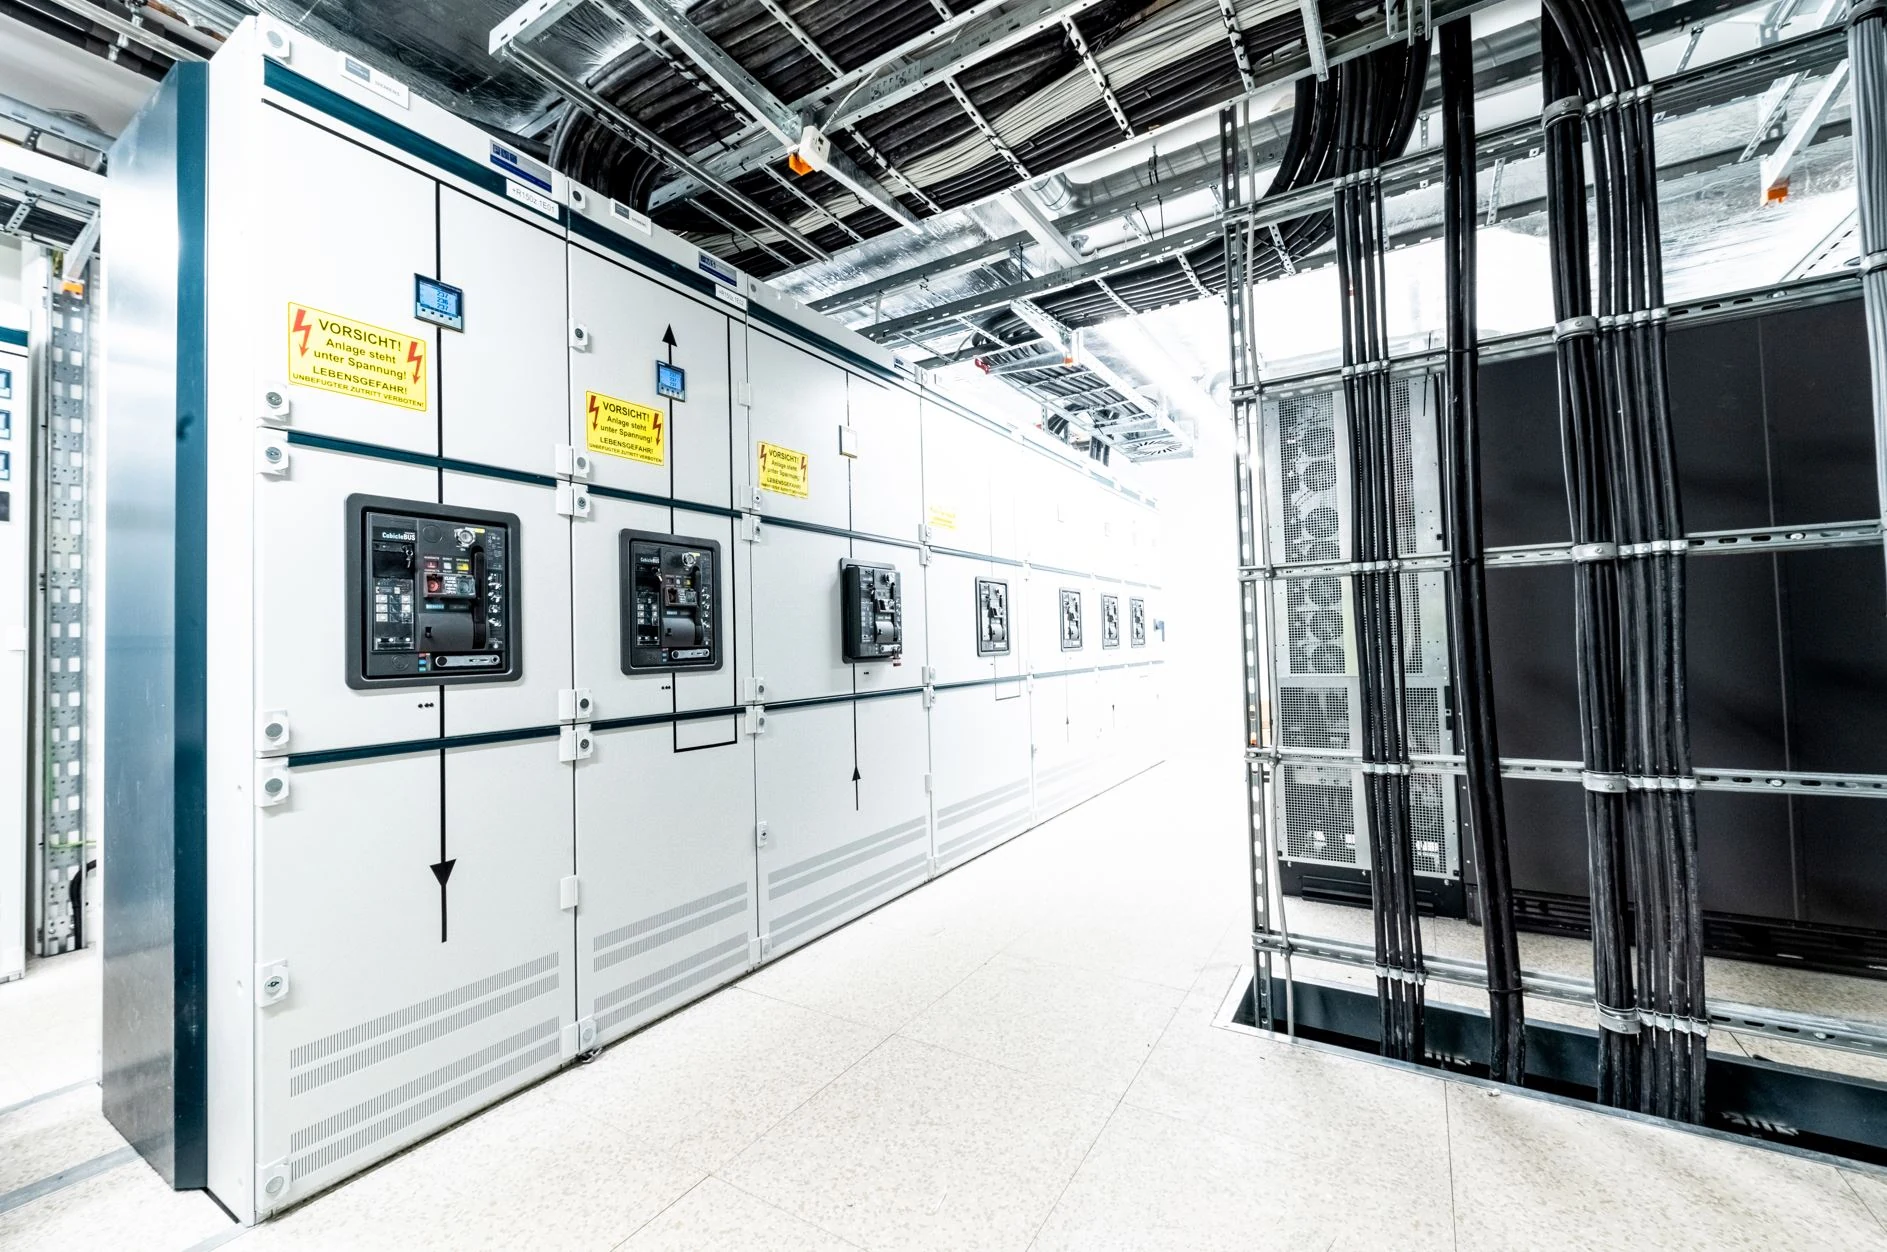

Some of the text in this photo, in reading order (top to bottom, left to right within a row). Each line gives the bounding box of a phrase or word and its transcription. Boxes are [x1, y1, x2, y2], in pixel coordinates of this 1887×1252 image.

[318, 318, 401, 351] VORSICHT!
[326, 338, 396, 364] Anlage steht
[314, 350, 407, 380] unter Spannung!
[293, 373, 424, 407] UNBEFUGTER ZUTRITT VERBOTEN!
[312, 366, 408, 394] LEBENSGEFAHR!
[602, 401, 650, 422] VORSICHT!
[600, 425, 653, 444] unter Spannung!
[607, 415, 647, 432] Anlage steht
[600, 436, 654, 454] LEBENSGEFAHR!
[382, 531, 416, 541] CubicleBUS
